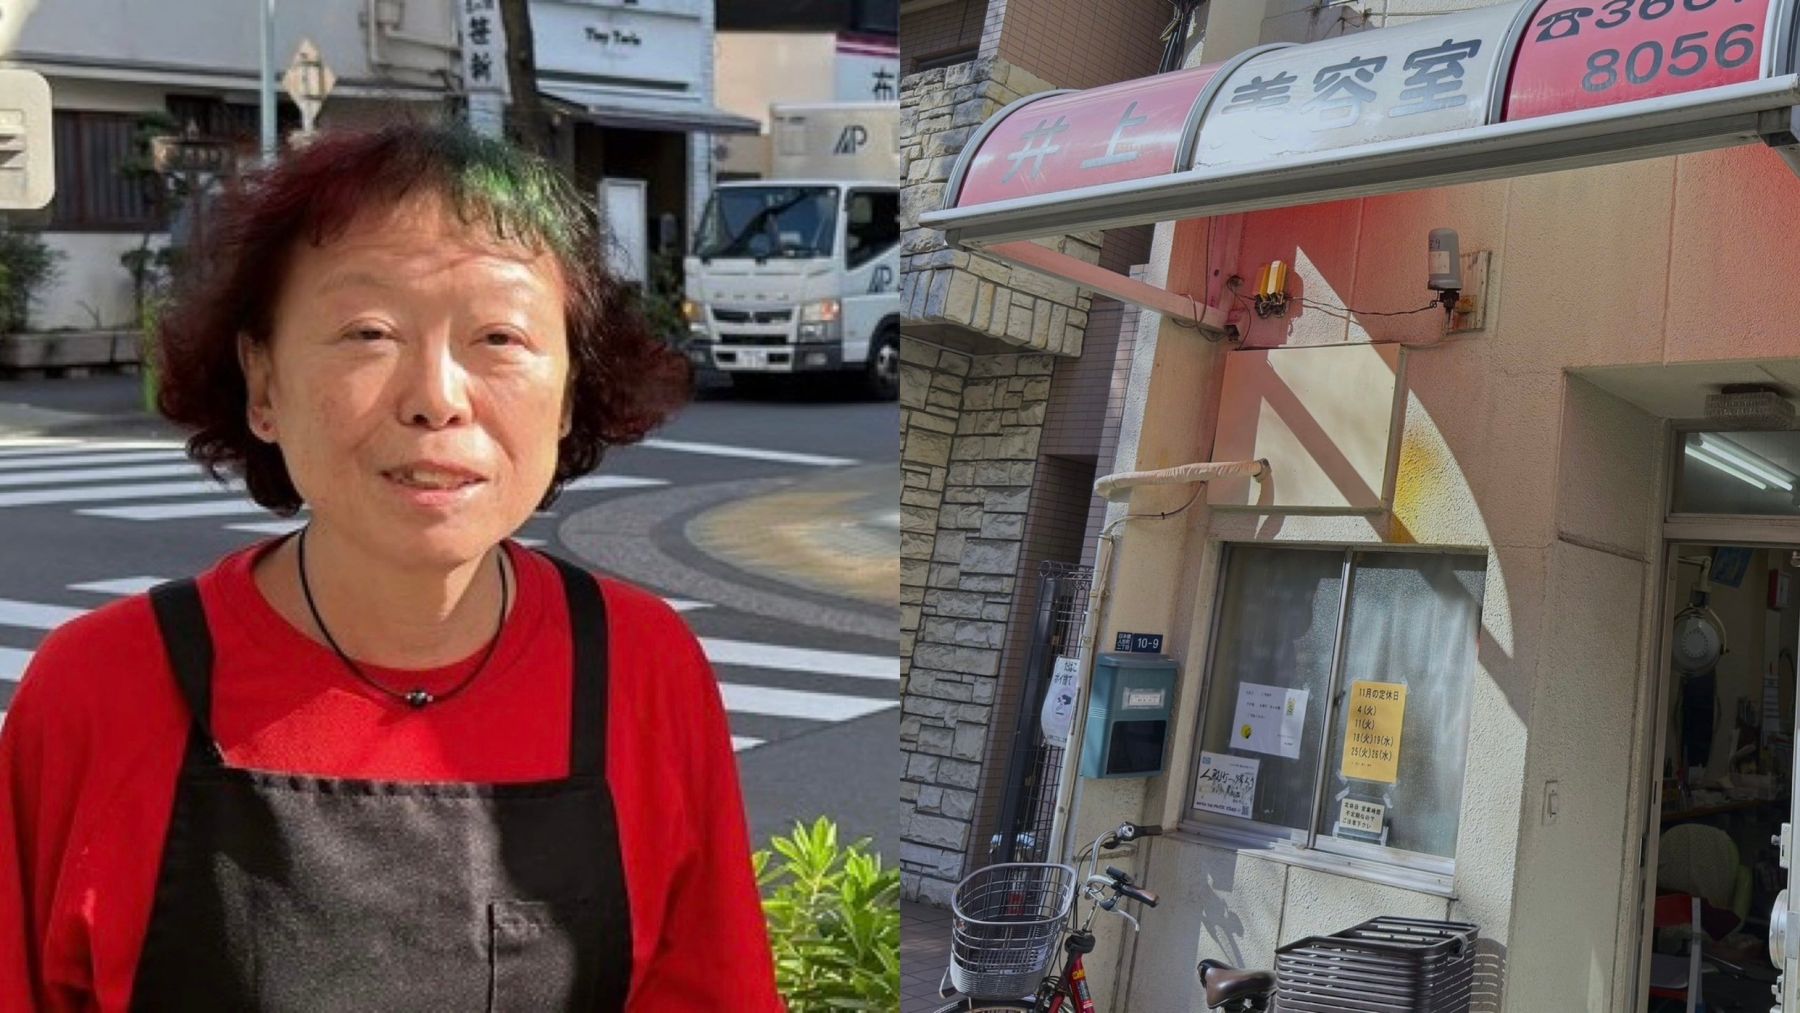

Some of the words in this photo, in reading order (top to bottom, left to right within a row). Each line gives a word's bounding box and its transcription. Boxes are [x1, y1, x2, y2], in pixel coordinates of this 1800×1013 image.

[1581, 23, 1756, 93] 8056
[1002, 100, 1147, 185] 井上
[1221, 38, 1482, 133] 美容室
[1137, 637, 1160, 649] 10-9
[1359, 687, 1399, 700] 11月の定休日
[1355, 719, 1375, 731] 11(火)
